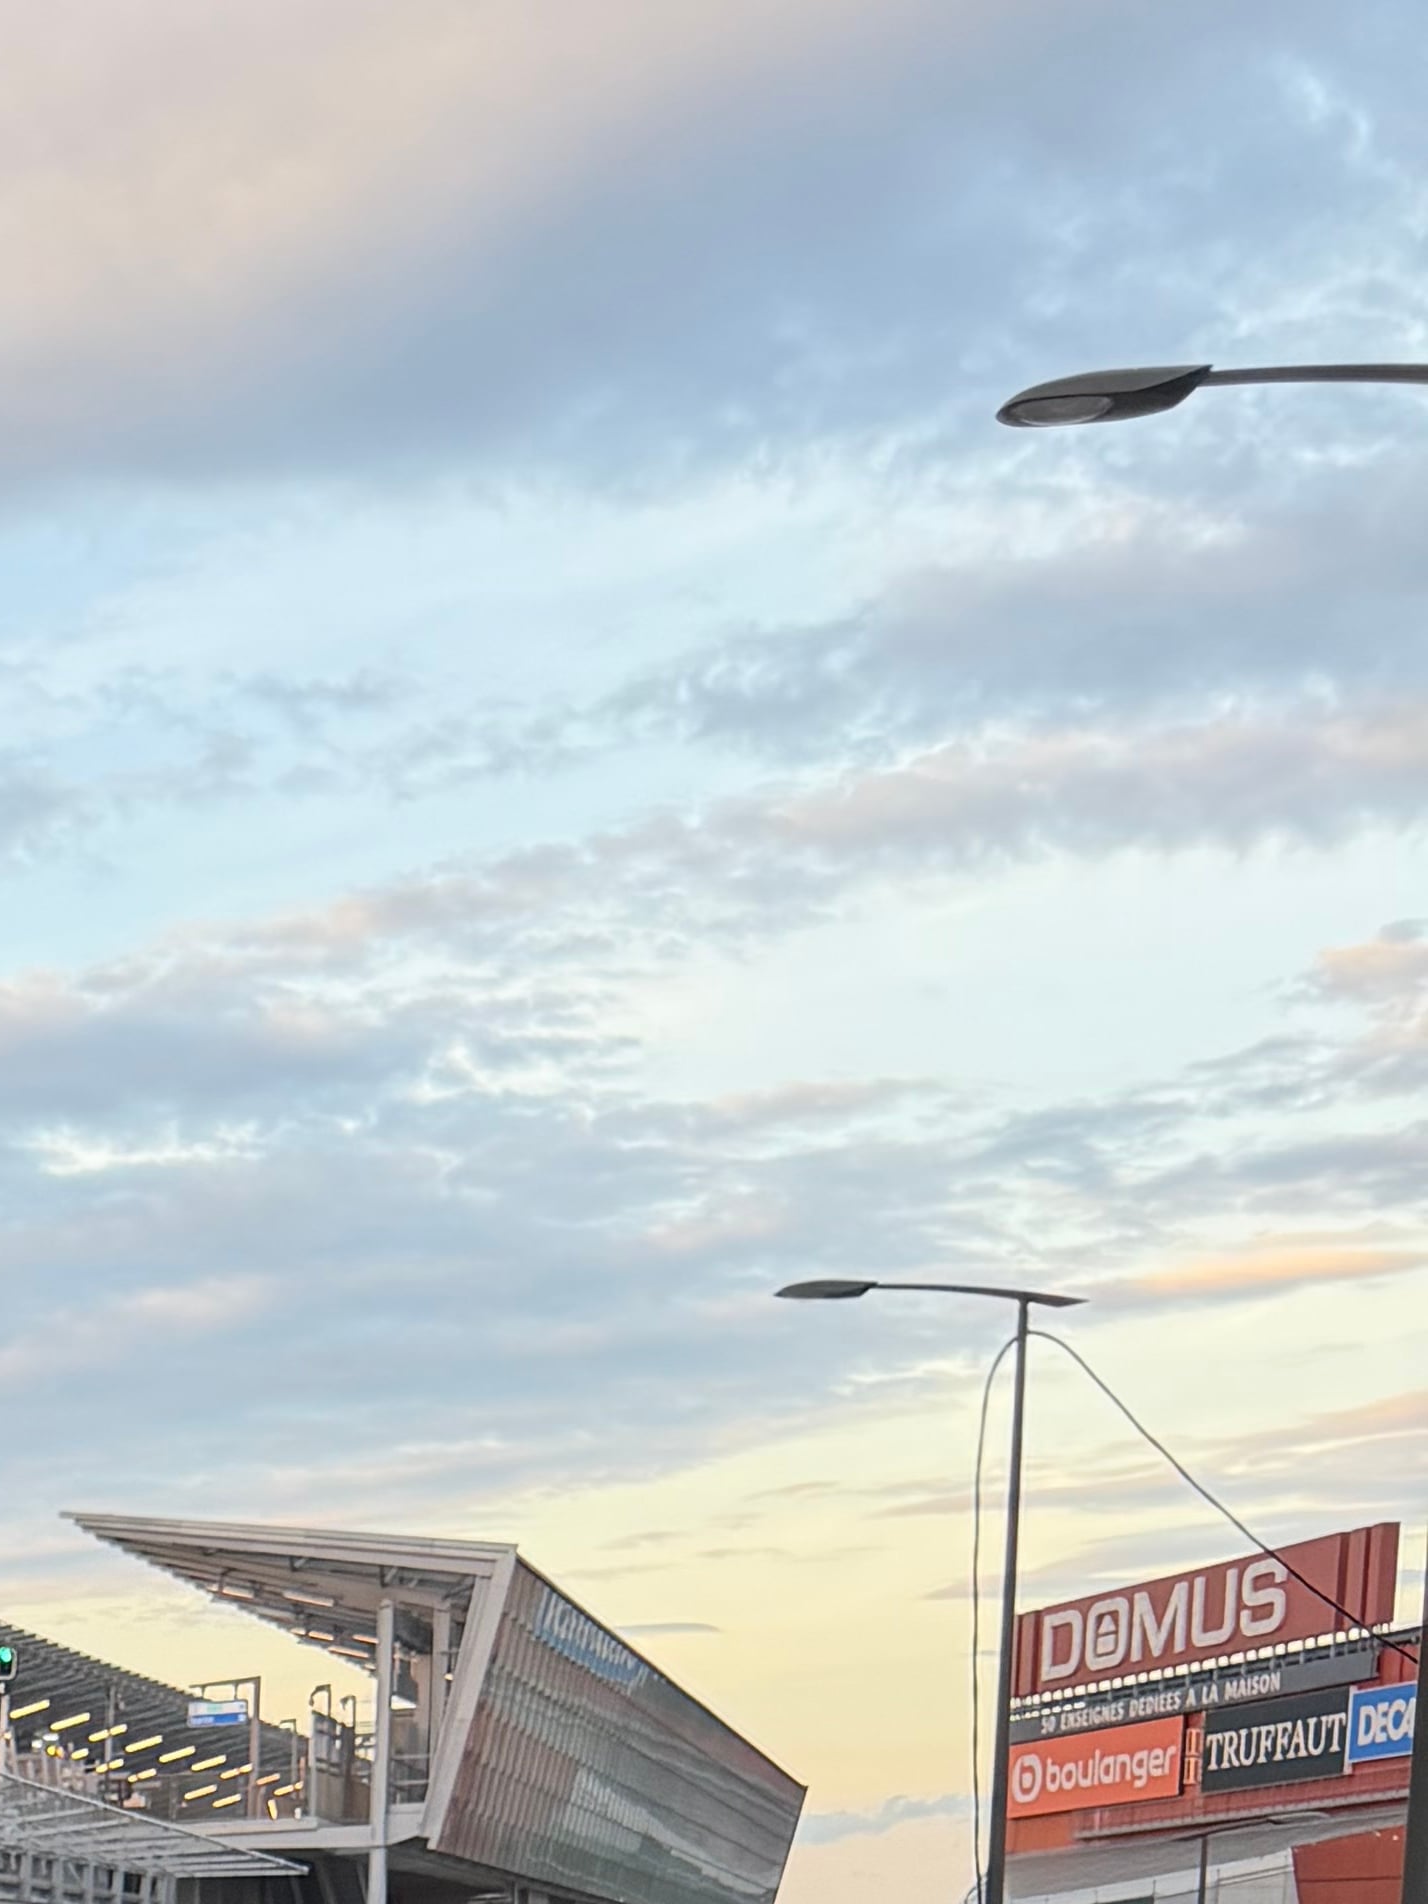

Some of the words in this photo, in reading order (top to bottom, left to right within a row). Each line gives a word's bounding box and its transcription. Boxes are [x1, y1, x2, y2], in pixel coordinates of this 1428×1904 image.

[1042, 1558, 1288, 1682] DOMUS
[1060, 1702, 1124, 1730] ENSEIGNES
[1202, 1683, 1219, 1704] LA
[1225, 1672, 1281, 1701] MAISON
[1046, 1745, 1177, 1792] boulanger
[1206, 1712, 1347, 1771] TRUFFAUT
